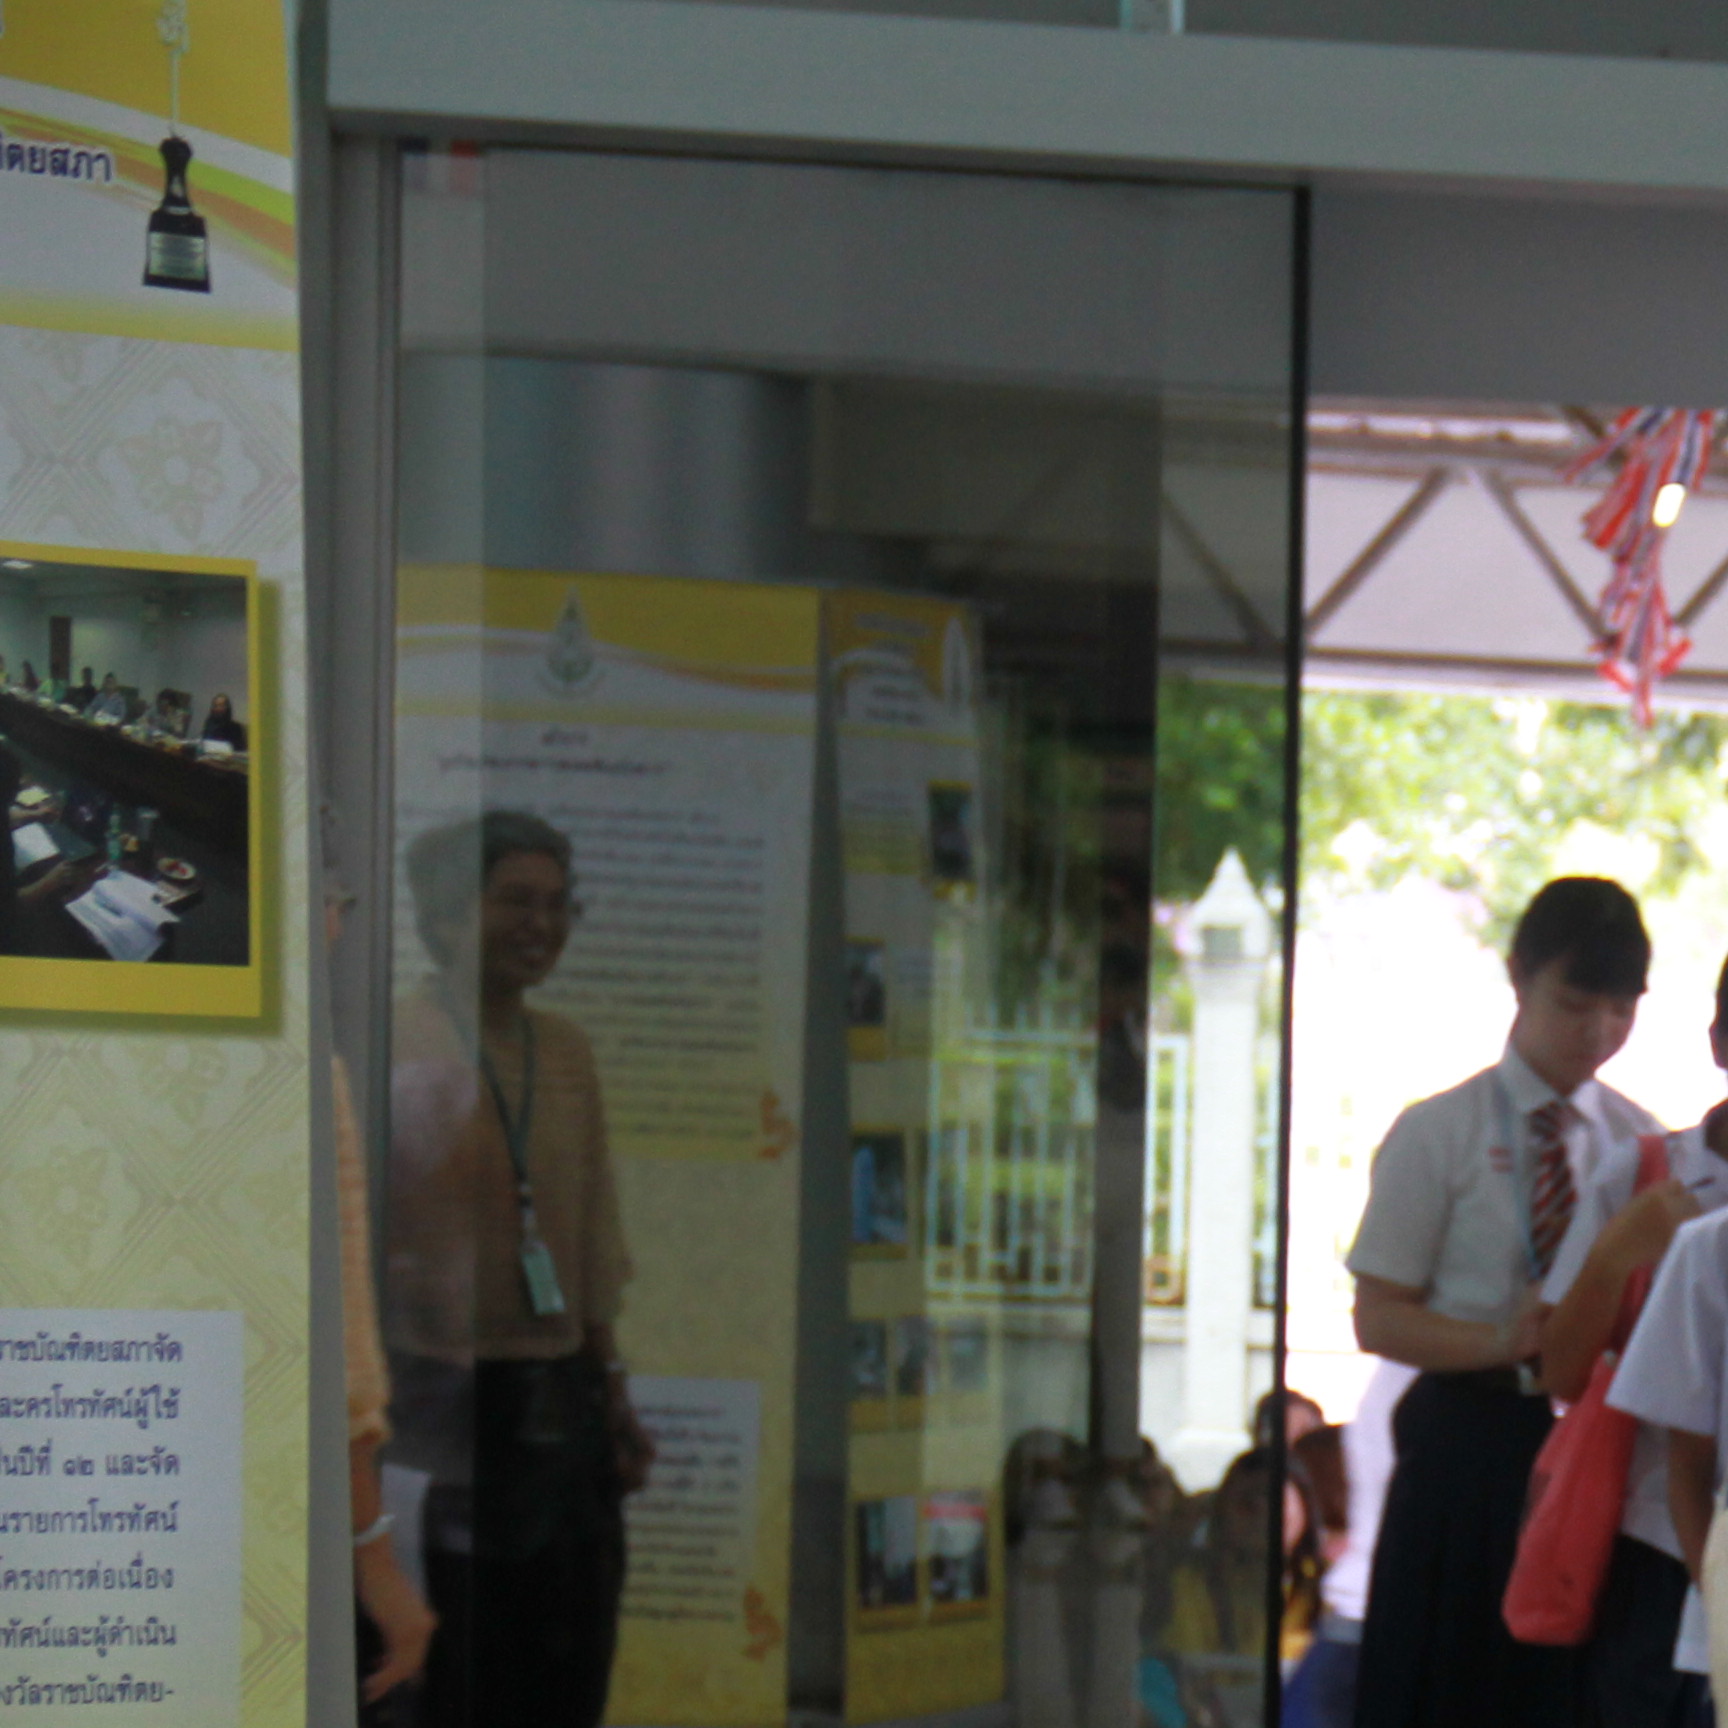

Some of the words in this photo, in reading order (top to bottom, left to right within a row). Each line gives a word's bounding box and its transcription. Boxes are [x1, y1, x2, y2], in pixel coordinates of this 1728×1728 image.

[0, 134, 112, 182] ตยสภา
[0, 1331, 182, 1362] าชบัณฑิตยสภาจัด
[0, 1438, 52, 1475] นปีที่
[105, 1446, 180, 1475] และจัด
[0, 1551, 174, 1590] ครงการต่อเนื่อง
